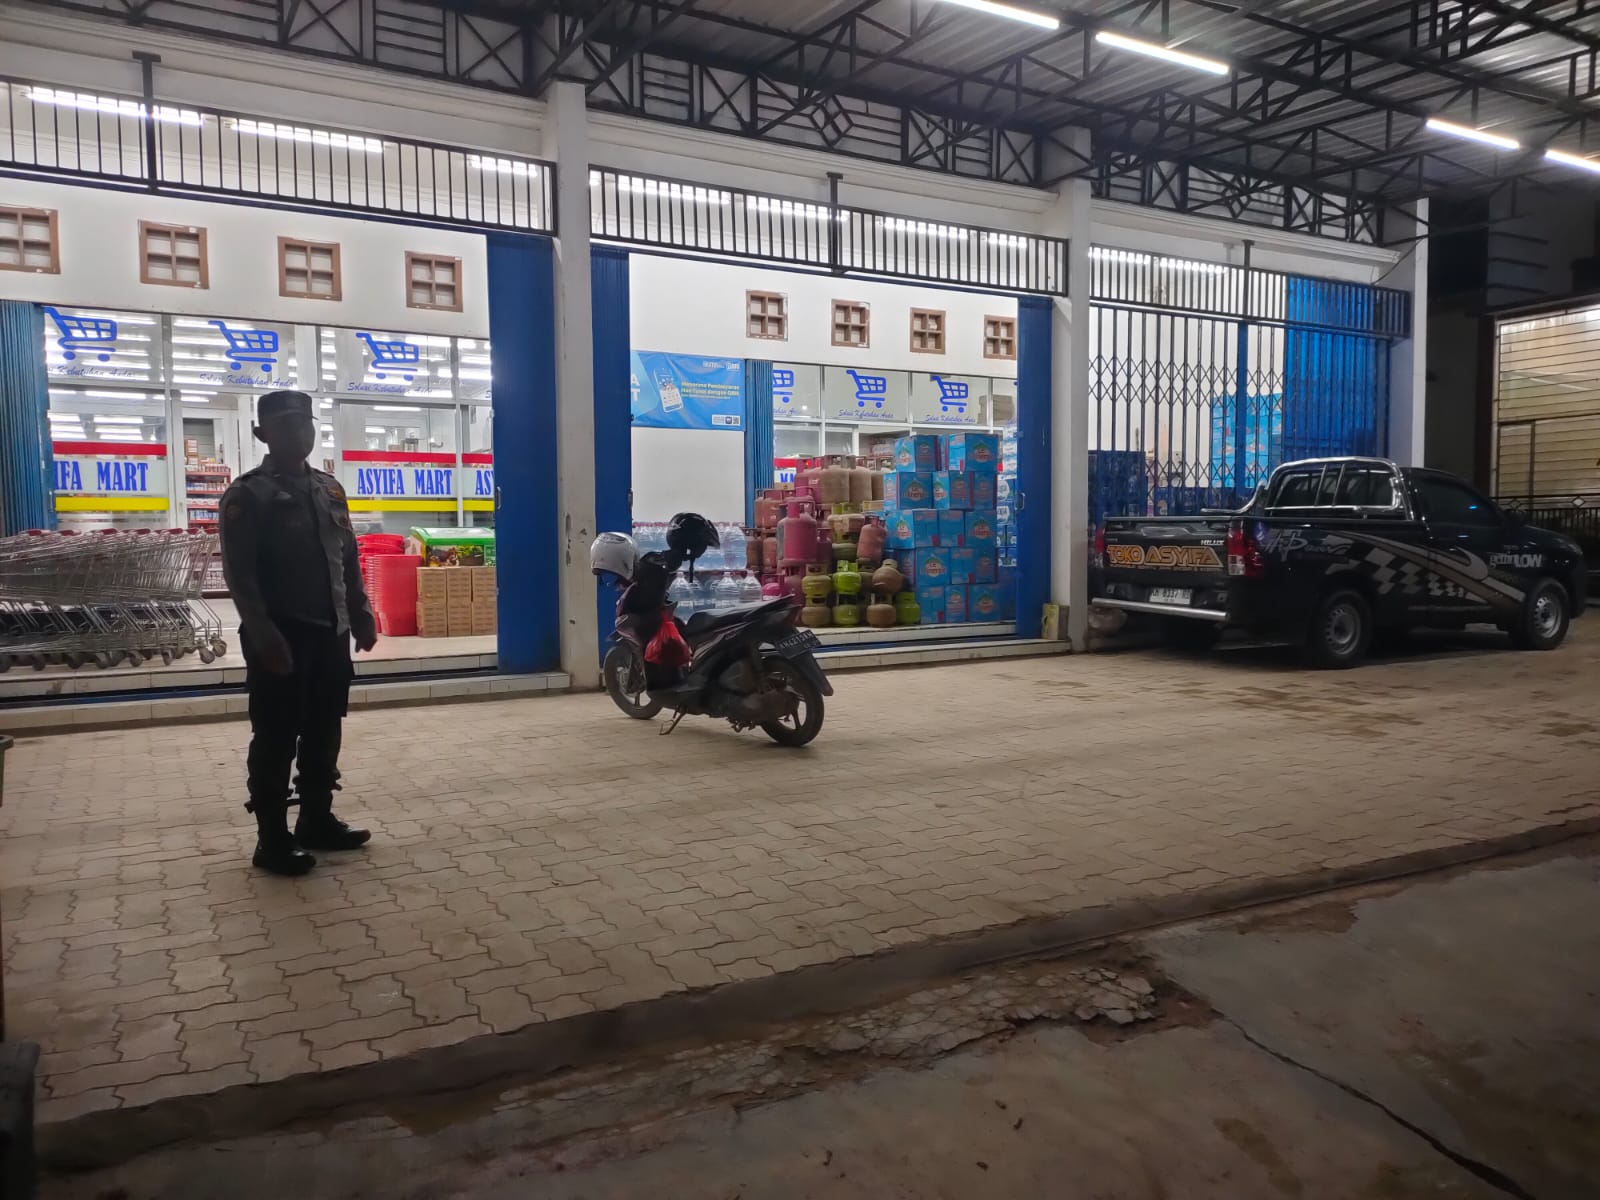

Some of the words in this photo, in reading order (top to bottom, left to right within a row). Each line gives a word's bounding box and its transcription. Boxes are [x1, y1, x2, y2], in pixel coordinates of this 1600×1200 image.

[96, 462, 148, 491] MART
[357, 468, 405, 495] ASYIFA
[414, 469, 452, 495] MART
[1107, 545, 1144, 564] TOKO
[1143, 545, 1224, 567] ASYIFA
